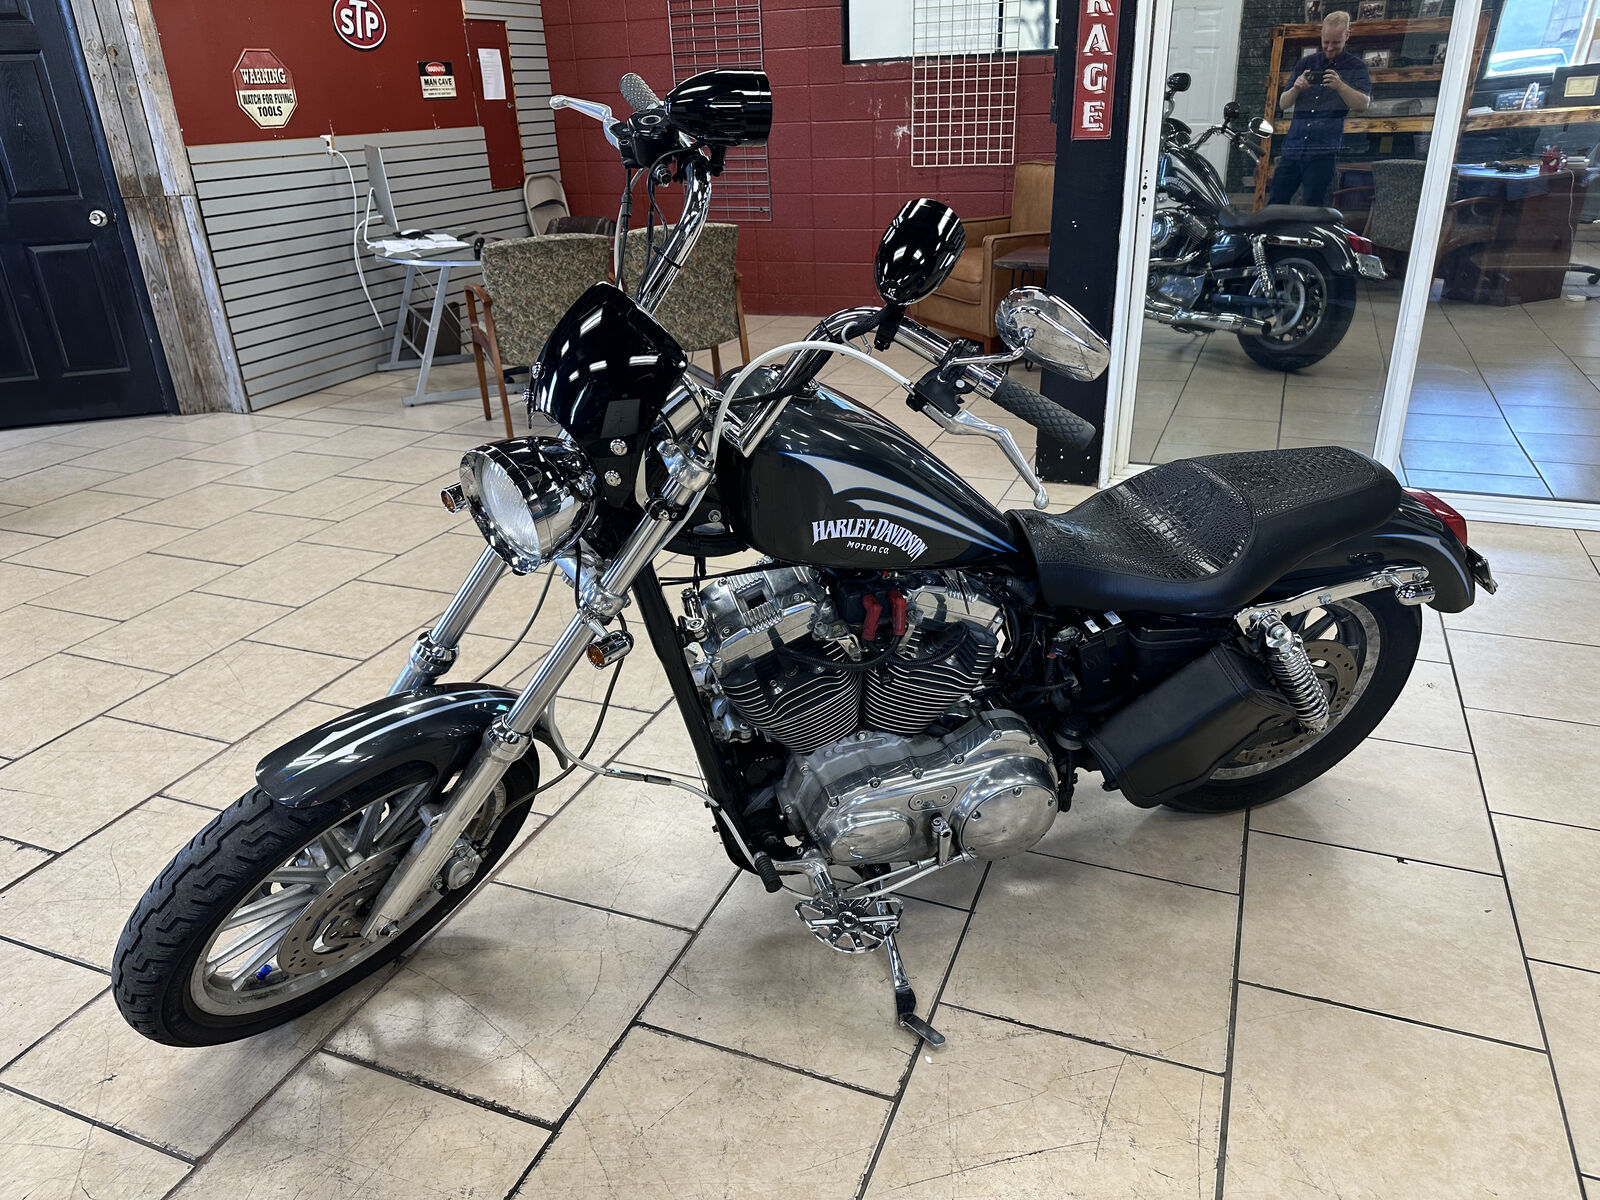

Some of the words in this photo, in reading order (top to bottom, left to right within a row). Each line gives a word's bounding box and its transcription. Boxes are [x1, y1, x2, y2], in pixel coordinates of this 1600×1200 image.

[340, 0, 380, 39] STP
[240, 68, 287, 84] WARNING
[423, 78, 438, 86] MAN
[438, 77, 453, 86] CAVE
[242, 93, 262, 105] WATCH
[262, 93, 274, 105] FOR
[274, 93, 294, 104] FLYING
[257, 105, 283, 117] TOOLS
[846, 540, 876, 553] MOTOR
